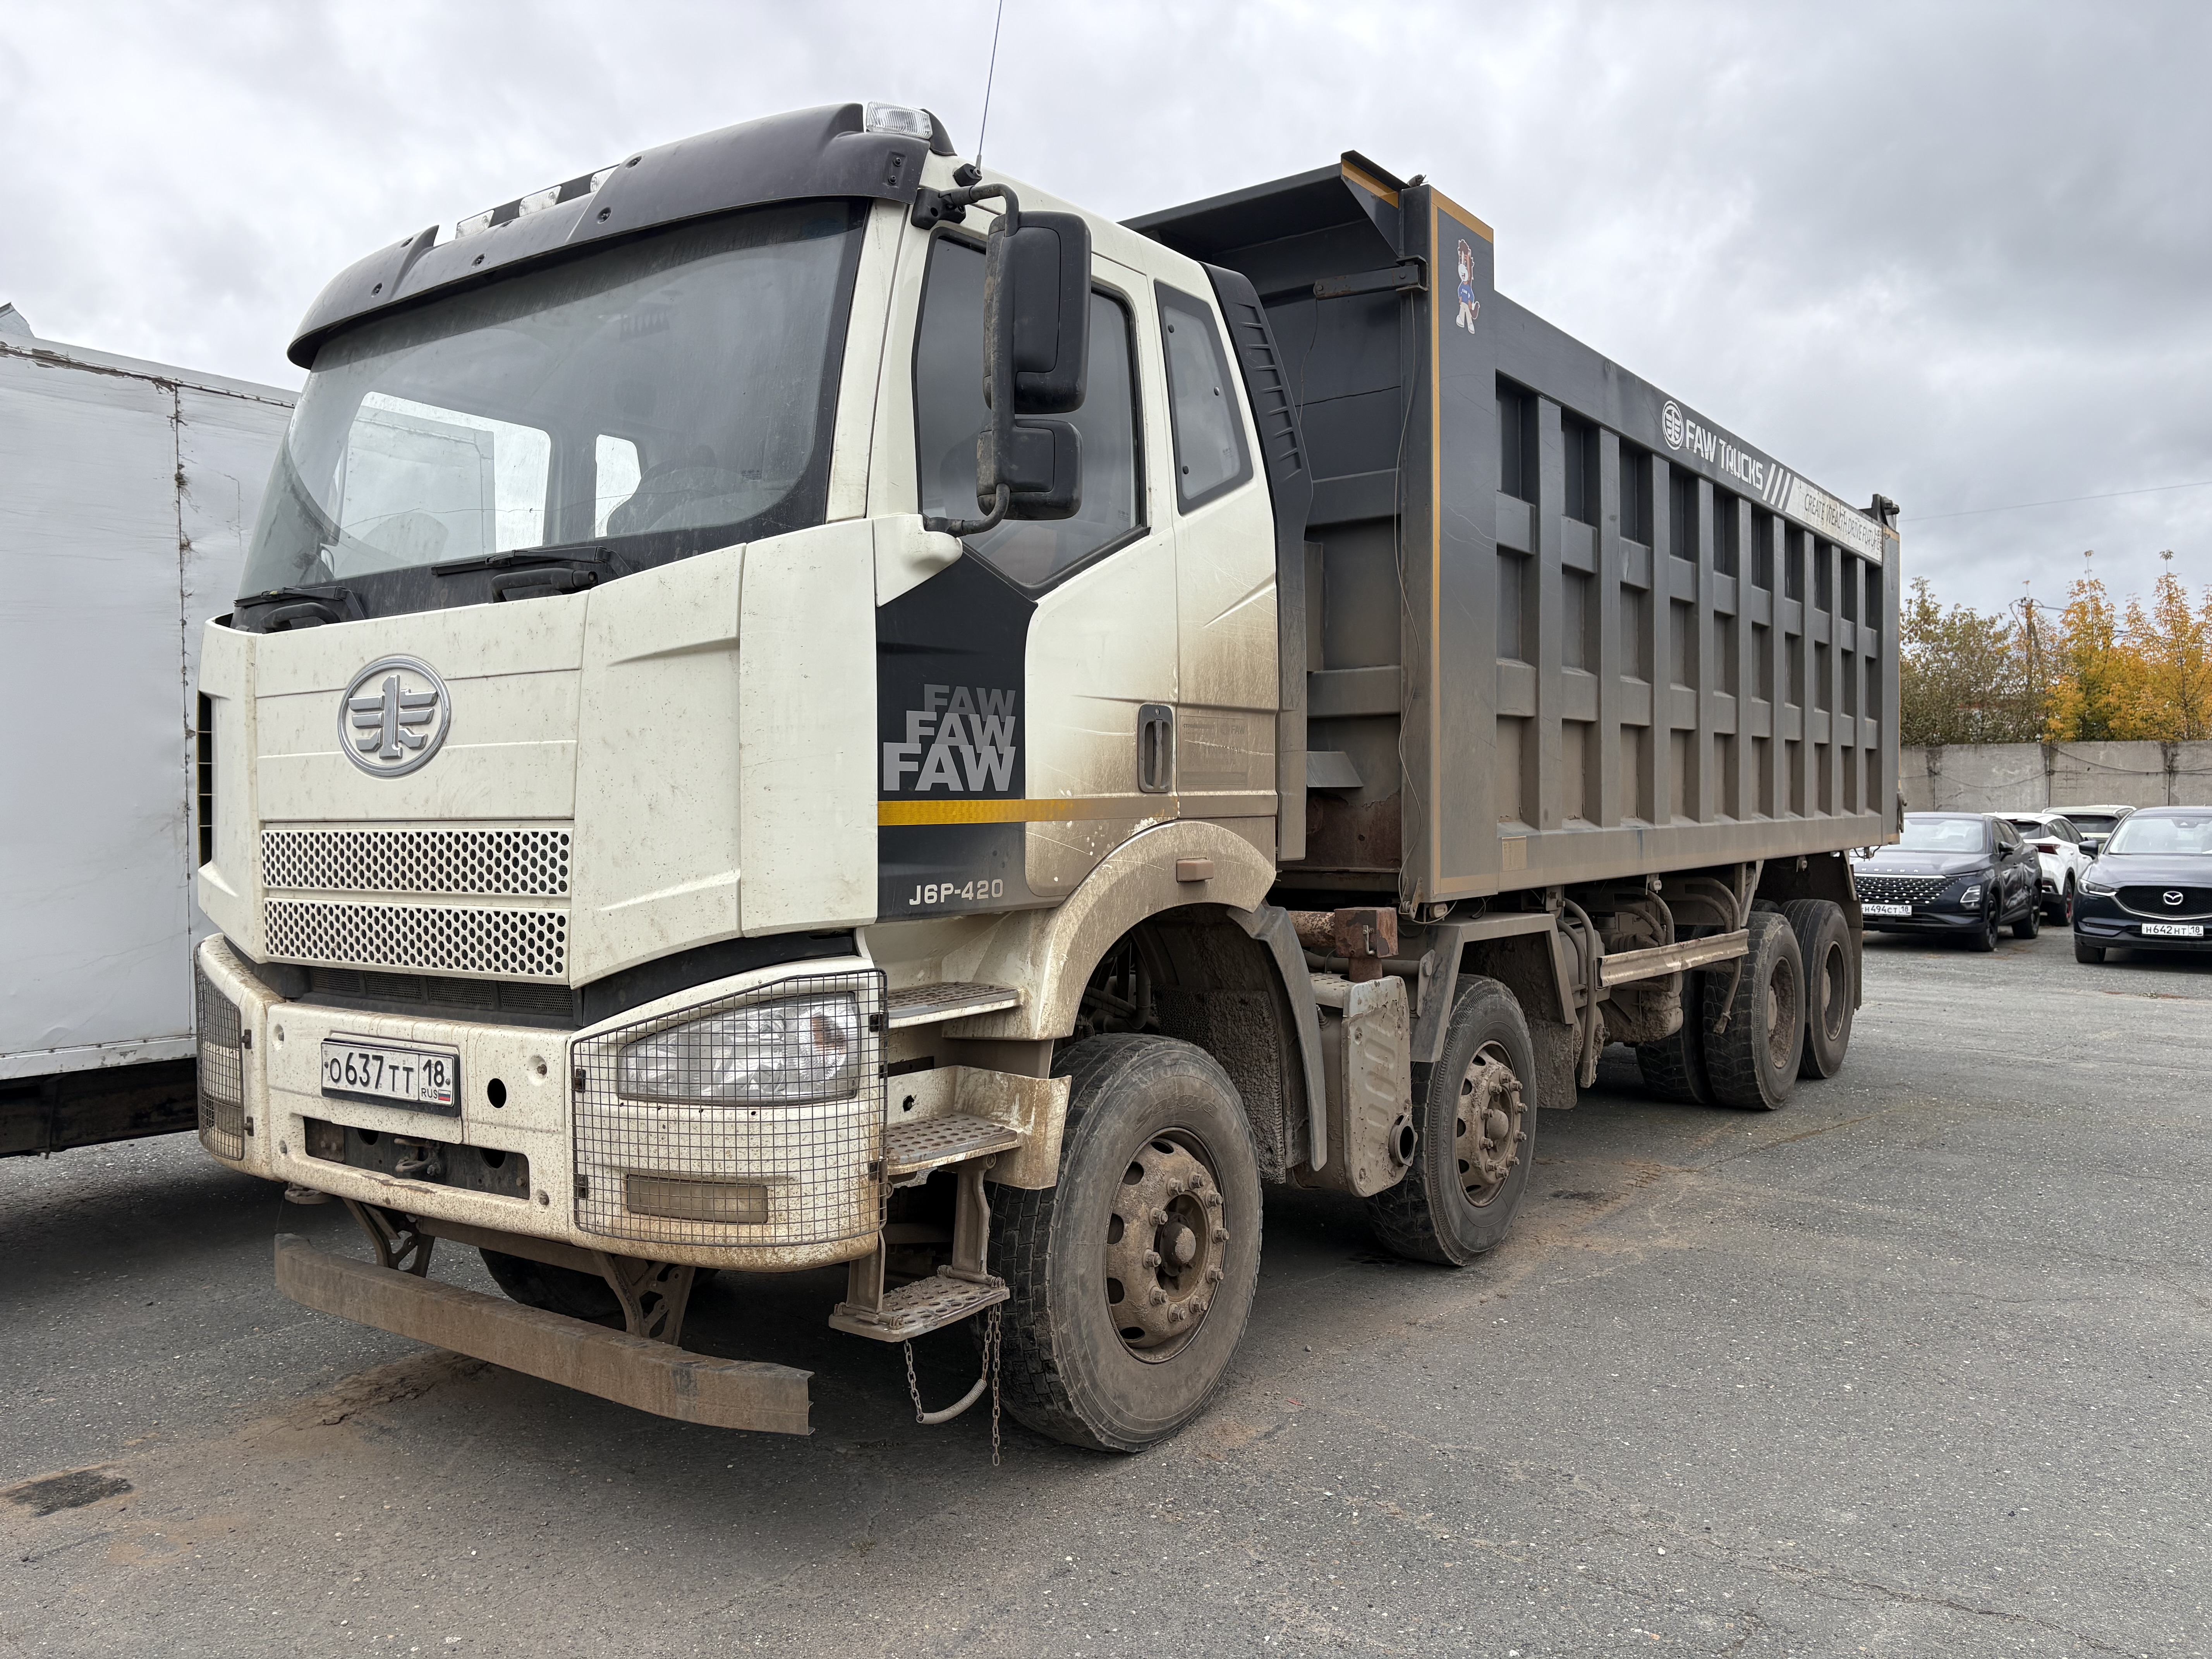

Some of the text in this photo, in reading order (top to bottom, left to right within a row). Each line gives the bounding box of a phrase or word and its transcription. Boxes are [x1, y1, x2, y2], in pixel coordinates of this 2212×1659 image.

[1686, 419, 1763, 491] FAW TRUCKS
[1805, 493, 1825, 520] CREATE
[1848, 518, 1862, 541] DRIVE
[924, 684, 1016, 723] FAW
[906, 710, 1016, 754] FAW
[1231, 725, 1245, 735] FAW
[883, 742, 1016, 791] FAW
[909, 879, 1003, 905] J6P-420
[1865, 905, 1898, 914] Н494СТ
[2146, 925, 2186, 935] Н642НТ
[422, 1059, 445, 1087] 18
[421, 1088, 438, 1099] RUS
